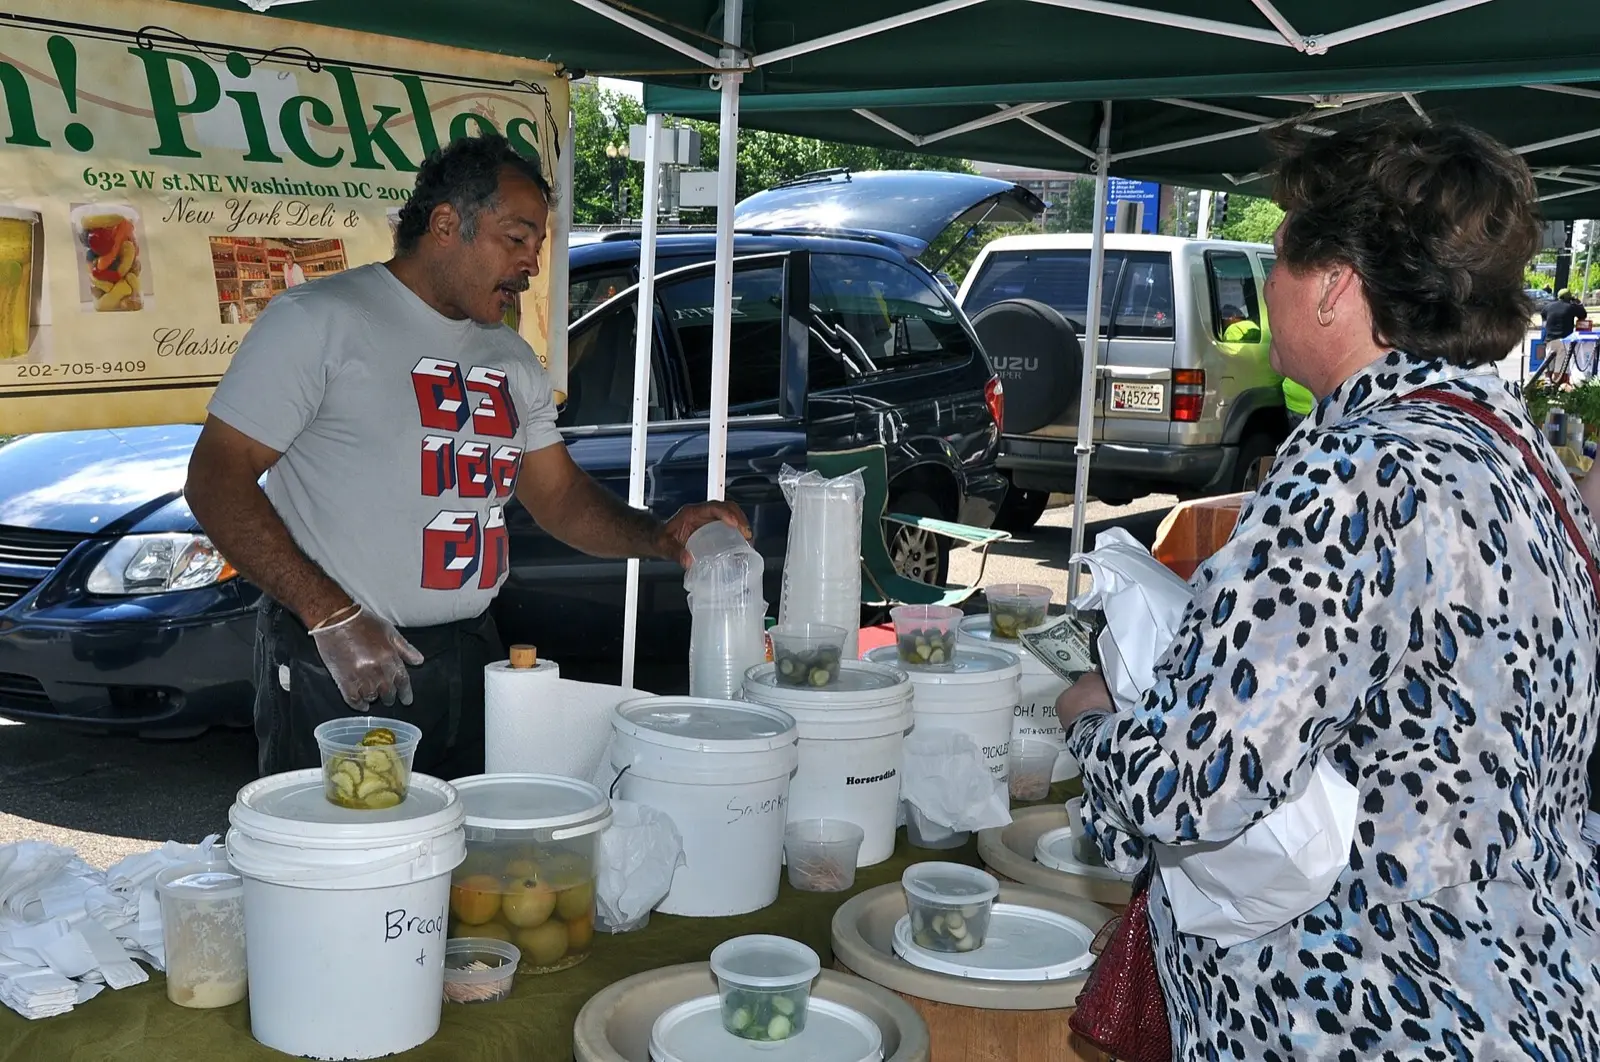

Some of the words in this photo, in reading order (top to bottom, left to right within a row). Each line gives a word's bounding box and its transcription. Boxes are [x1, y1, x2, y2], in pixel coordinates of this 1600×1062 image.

[83, 167, 127, 191] 632
[129, 169, 155, 189] W
[162, 173, 223, 193] st.NE
[225, 175, 340, 198] Washinton
[342, 181, 373, 199] DC
[376, 186, 413, 201] 200
[162, 196, 216, 223] New
[225, 198, 283, 233] York
[286, 200, 336, 228] Deli
[343, 209, 360, 228] &
[152, 327, 239, 357] Classic
[17, 360, 147, 378] 202-705-9409
[990, 356, 1038, 371] UZU
[1014, 703, 1035, 717] OH!
[846, 768, 896, 785] Horseradish
[384, 905, 444, 942] Bread
